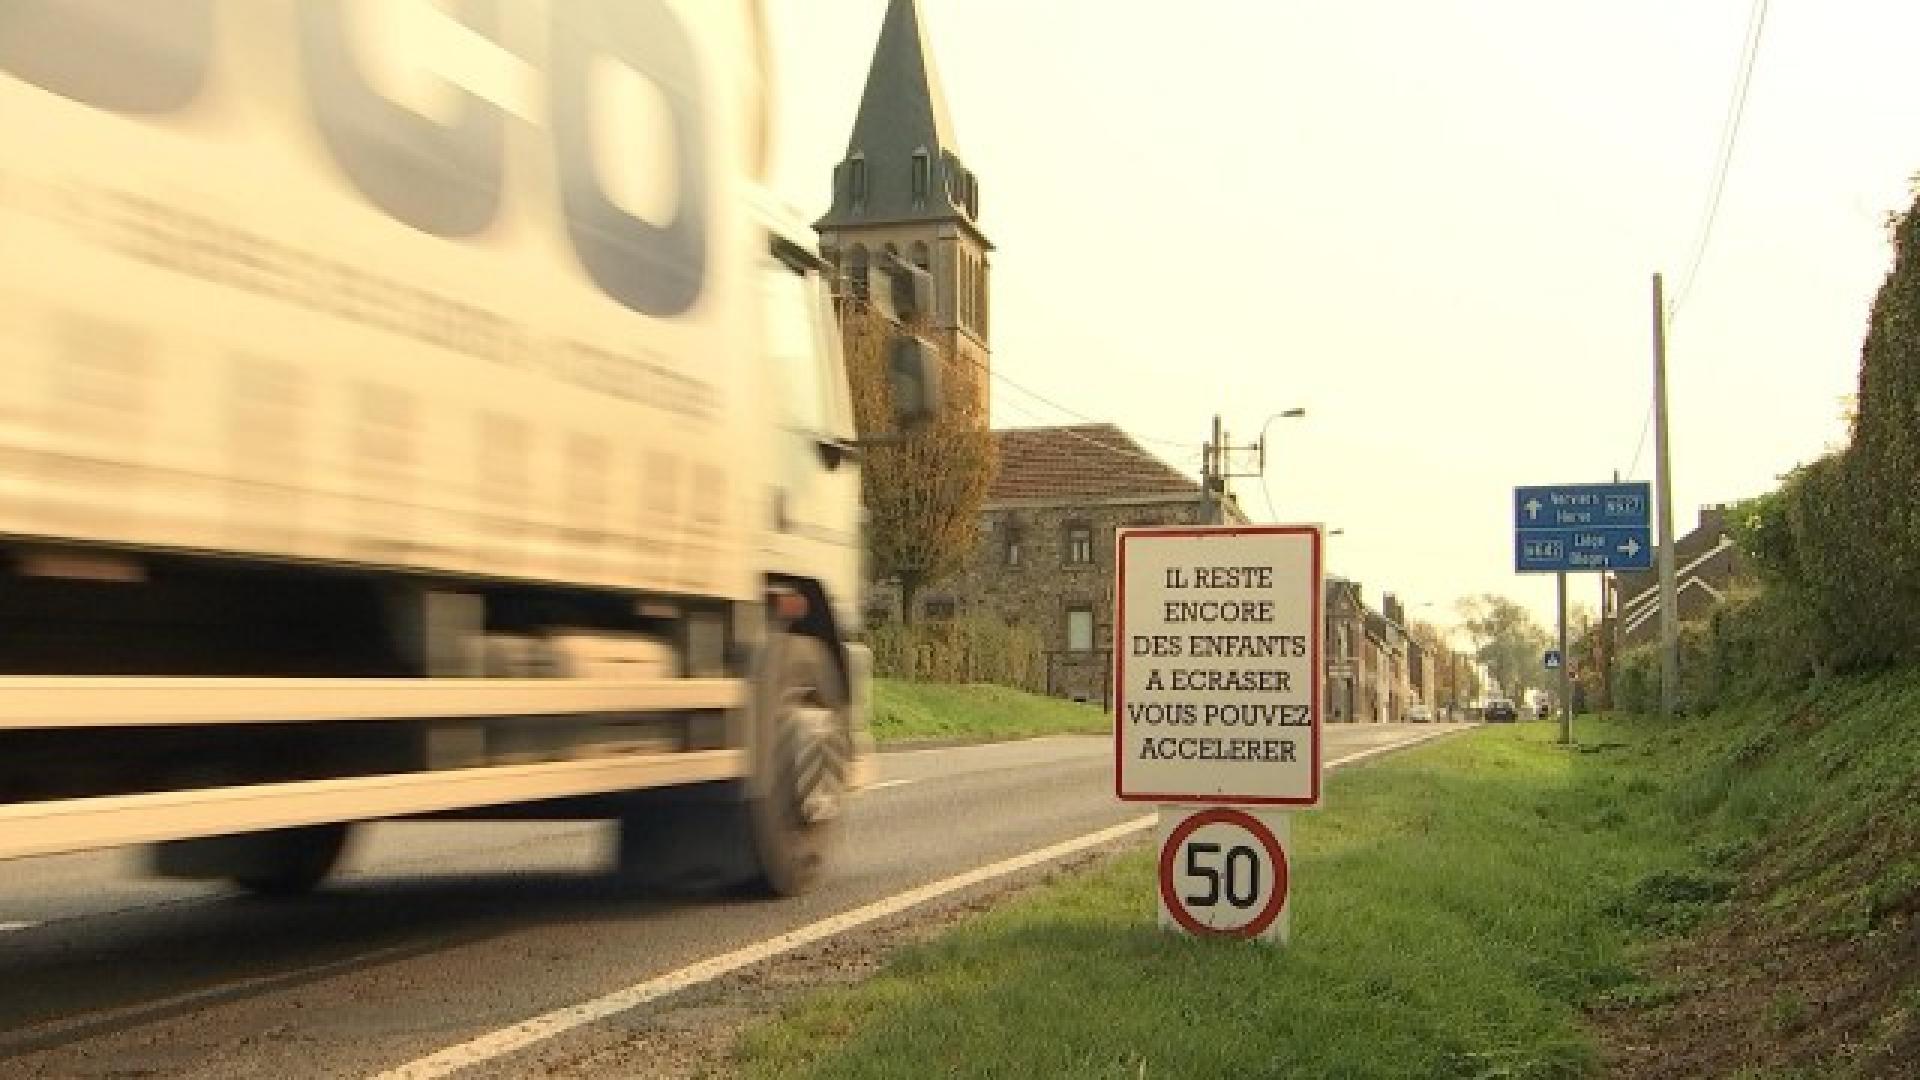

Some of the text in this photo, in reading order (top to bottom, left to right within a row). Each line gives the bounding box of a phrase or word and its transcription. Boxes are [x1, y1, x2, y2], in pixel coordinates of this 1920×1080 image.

[1163, 567, 1273, 588] IL RESTE
[1164, 600, 1275, 624] ENCORE
[1132, 636, 1306, 657] DES ENFANTS
[1146, 669, 1292, 692] A ECRASER
[1128, 702, 1312, 726] VOUS POUVEZ
[1140, 738, 1297, 762] ACCELERER
[1186, 843, 1260, 909] 50
